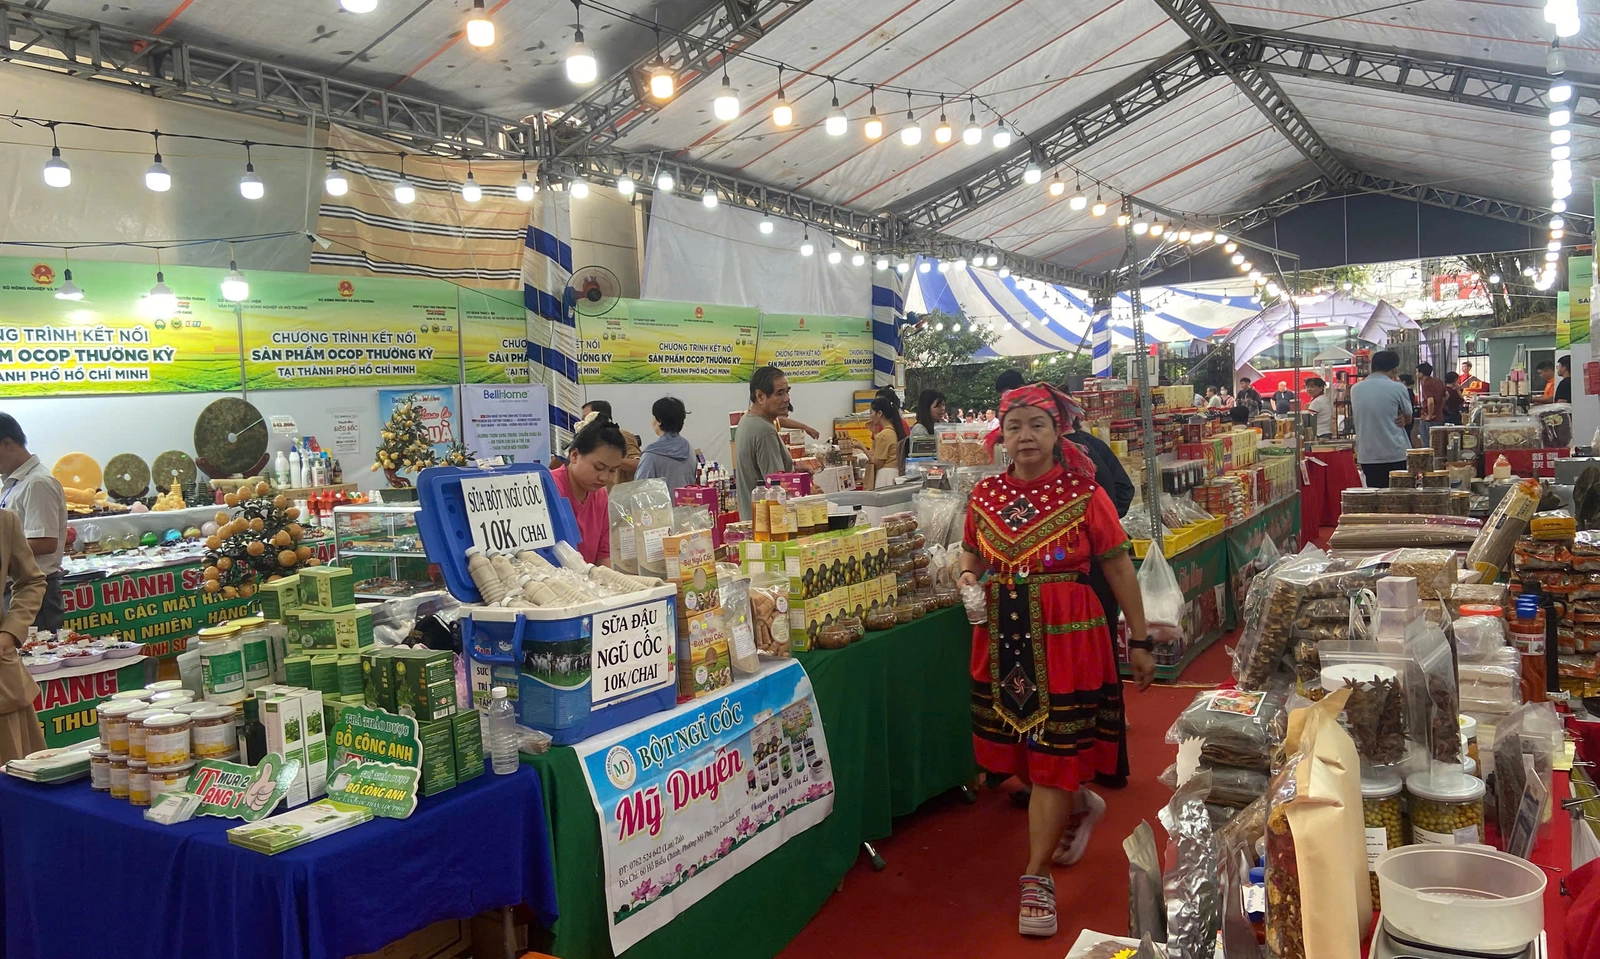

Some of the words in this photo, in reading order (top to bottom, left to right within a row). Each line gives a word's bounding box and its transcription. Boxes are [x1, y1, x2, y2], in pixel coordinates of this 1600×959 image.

[24, 326, 77, 342] TRÌNH
[84, 326, 114, 342] KẾT
[120, 327, 148, 342] NỐI
[273, 331, 328, 343] CHƯƠNG
[332, 330, 368, 342] TRÌNH
[372, 331, 393, 342] KẾT
[397, 331, 416, 343] NỐI
[502, 339, 528, 348] CHƯƠ
[586, 338, 600, 348] NỐI
[18, 350, 70, 362] OCOP
[75, 347, 149, 362] THƯỜNG
[153, 347, 174, 361] KỲ
[252, 347, 282, 360] SẢN
[286, 346, 324, 360] PHẨM
[328, 350, 363, 359] OCOP
[366, 348, 415, 359] THƯỜNG
[419, 348, 433, 359] KỲ
[489, 351, 509, 362] SẢN
[577, 352, 600, 362] ƯỜNG
[602, 352, 612, 362] KỲ
[659, 342, 688, 351] CHƯƠNG
[689, 343, 708, 352] TRÌNH
[710, 343, 721, 352] KẾT
[722, 344, 733, 352] NỐI
[648, 353, 664, 363] SẢN
[665, 353, 684, 363] PHẨM
[706, 355, 732, 364] THƯỜNG
[732, 356, 741, 364] KỲ
[31, 368, 60, 381] PHỐ
[65, 368, 85, 380] HỒ
[89, 368, 111, 380] CHÍ
[116, 370, 148, 379] MINH
[278, 367, 295, 378] TẠI
[298, 365, 333, 376] THÀNH
[336, 364, 356, 375] PHỐ
[359, 364, 372, 374] HỒ
[375, 364, 390, 374] CHÍ
[484, 390, 528, 399] BellHome
[468, 486, 486, 513] SỮA
[485, 484, 503, 515] BỘT
[504, 482, 522, 508] NGŨ
[523, 475, 542, 506] CỐC
[480, 519, 517, 551] 10K
[519, 524, 547, 547] /CHAI
[62, 582, 95, 613] GŨ
[102, 572, 175, 606] HÀNH
[124, 602, 158, 621] CÁC
[162, 595, 197, 614] MẶT
[141, 617, 193, 639] NHIÊN
[208, 604, 247, 624] HÀNG
[601, 615, 628, 635] SỮA
[631, 608, 657, 630] ĐẬU
[597, 640, 628, 669] NGŨ
[634, 629, 662, 659] CỐC
[604, 663, 657, 692] 10K/CHAI
[346, 713, 362, 725] TRÀ
[363, 716, 387, 731] THẢO
[386, 722, 410, 737] DƯỢC
[637, 735, 674, 768] BỘT
[710, 698, 742, 734] CỐC
[355, 733, 386, 755] CÔNG
[388, 743, 413, 762] ANH
[195, 767, 234, 806] TẶNG
[233, 792, 244, 808] 1
[218, 772, 241, 786] MUA
[241, 776, 250, 788] 2
[360, 783, 385, 798] CÔNG
[384, 788, 407, 800] ANH
[616, 786, 664, 841] Mỹ
[667, 746, 744, 812] Duyên
